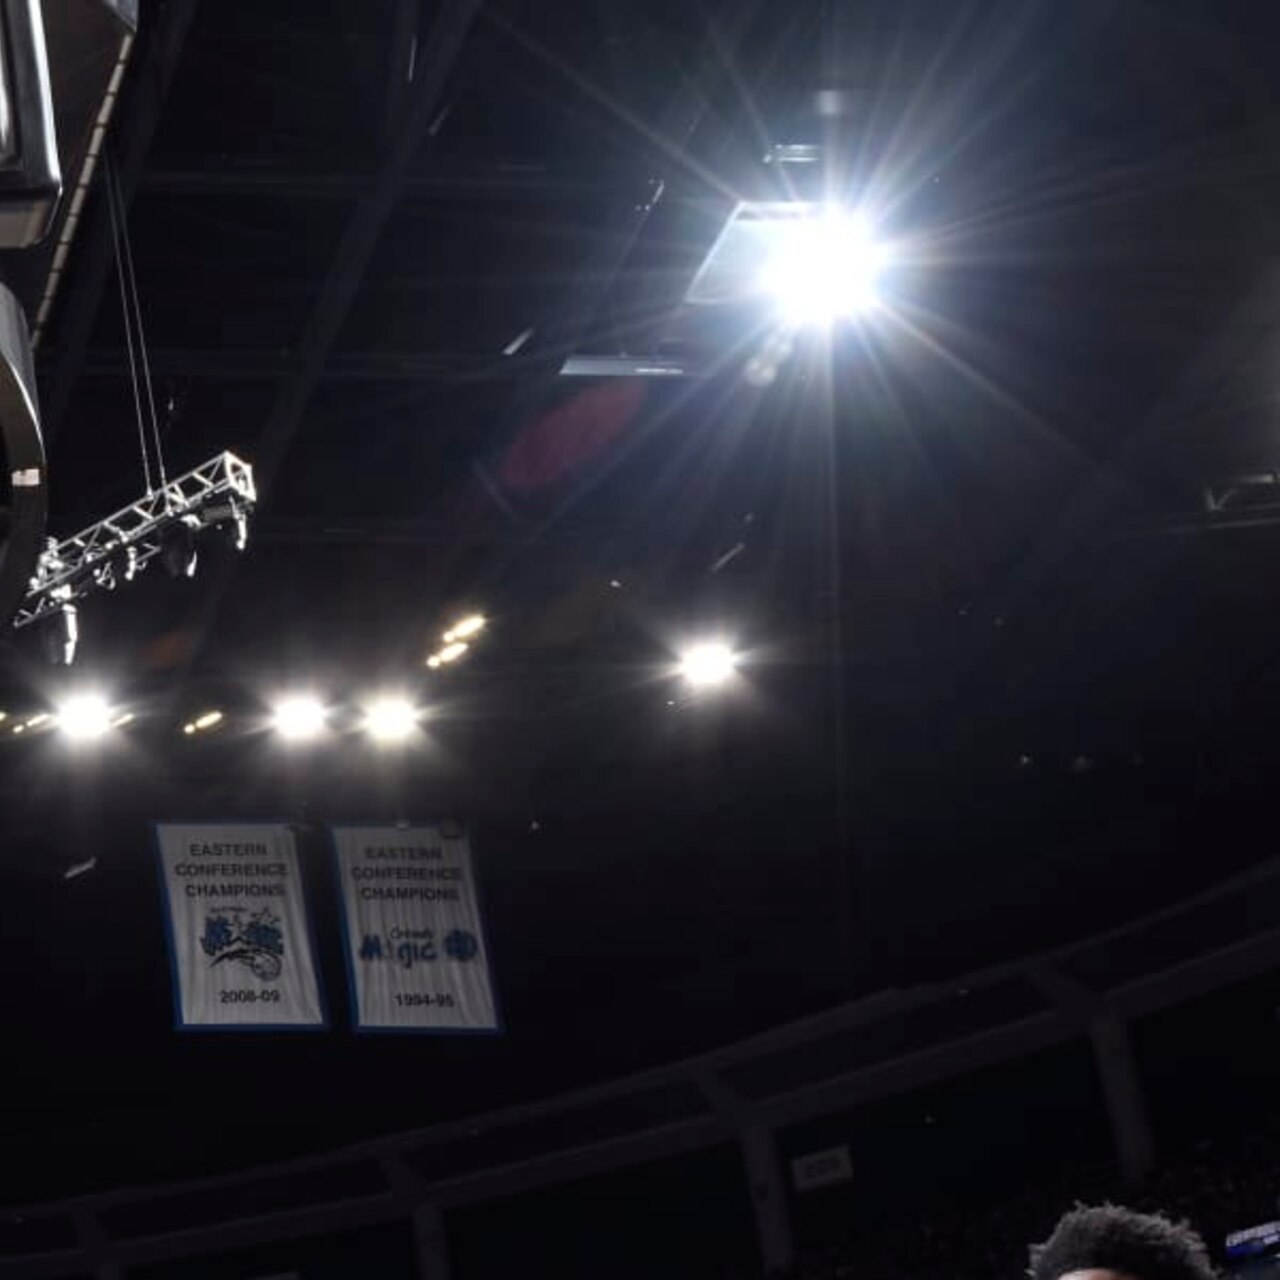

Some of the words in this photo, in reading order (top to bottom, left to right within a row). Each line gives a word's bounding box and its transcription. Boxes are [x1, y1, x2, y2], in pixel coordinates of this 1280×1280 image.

[191, 844, 267, 856] EASTERN
[366, 848, 443, 860] EASTERN
[176, 864, 288, 877] CONFERENCE
[352, 867, 462, 880] CONFERENCE
[186, 885, 286, 896] CHAMPIONS
[361, 887, 460, 900] CHAMPIONS
